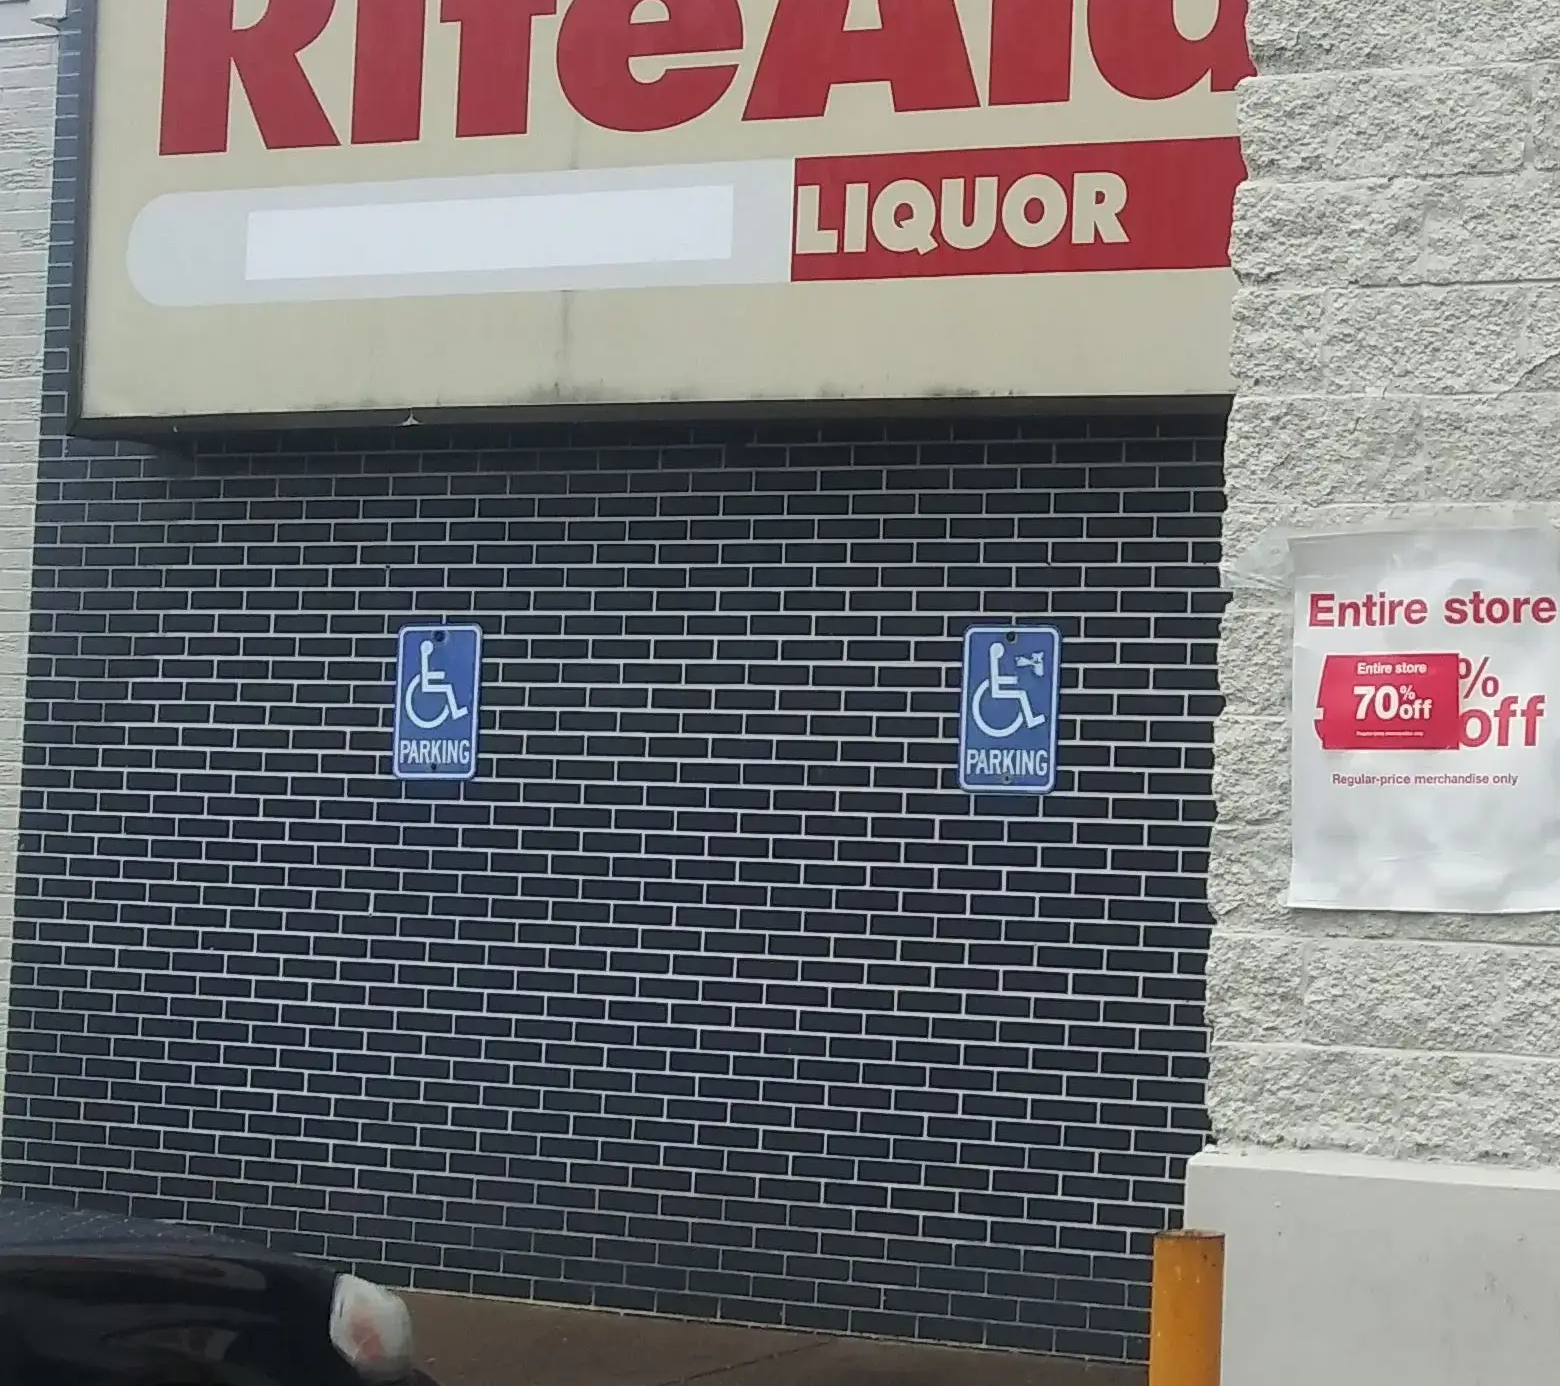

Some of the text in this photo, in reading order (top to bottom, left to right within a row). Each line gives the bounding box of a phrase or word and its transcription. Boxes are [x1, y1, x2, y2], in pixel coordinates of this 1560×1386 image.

[795, 170, 1129, 254] LIQUOR
[1308, 591, 1557, 628] Entire store
[1357, 662, 1427, 674] Entire store
[1400, 700, 1432, 720] off
[1459, 694, 1545, 748] off
[400, 739, 470, 765] PARKING
[967, 749, 1047, 776] PARKING
[1332, 773, 1518, 786] Regular-price merchandise only
